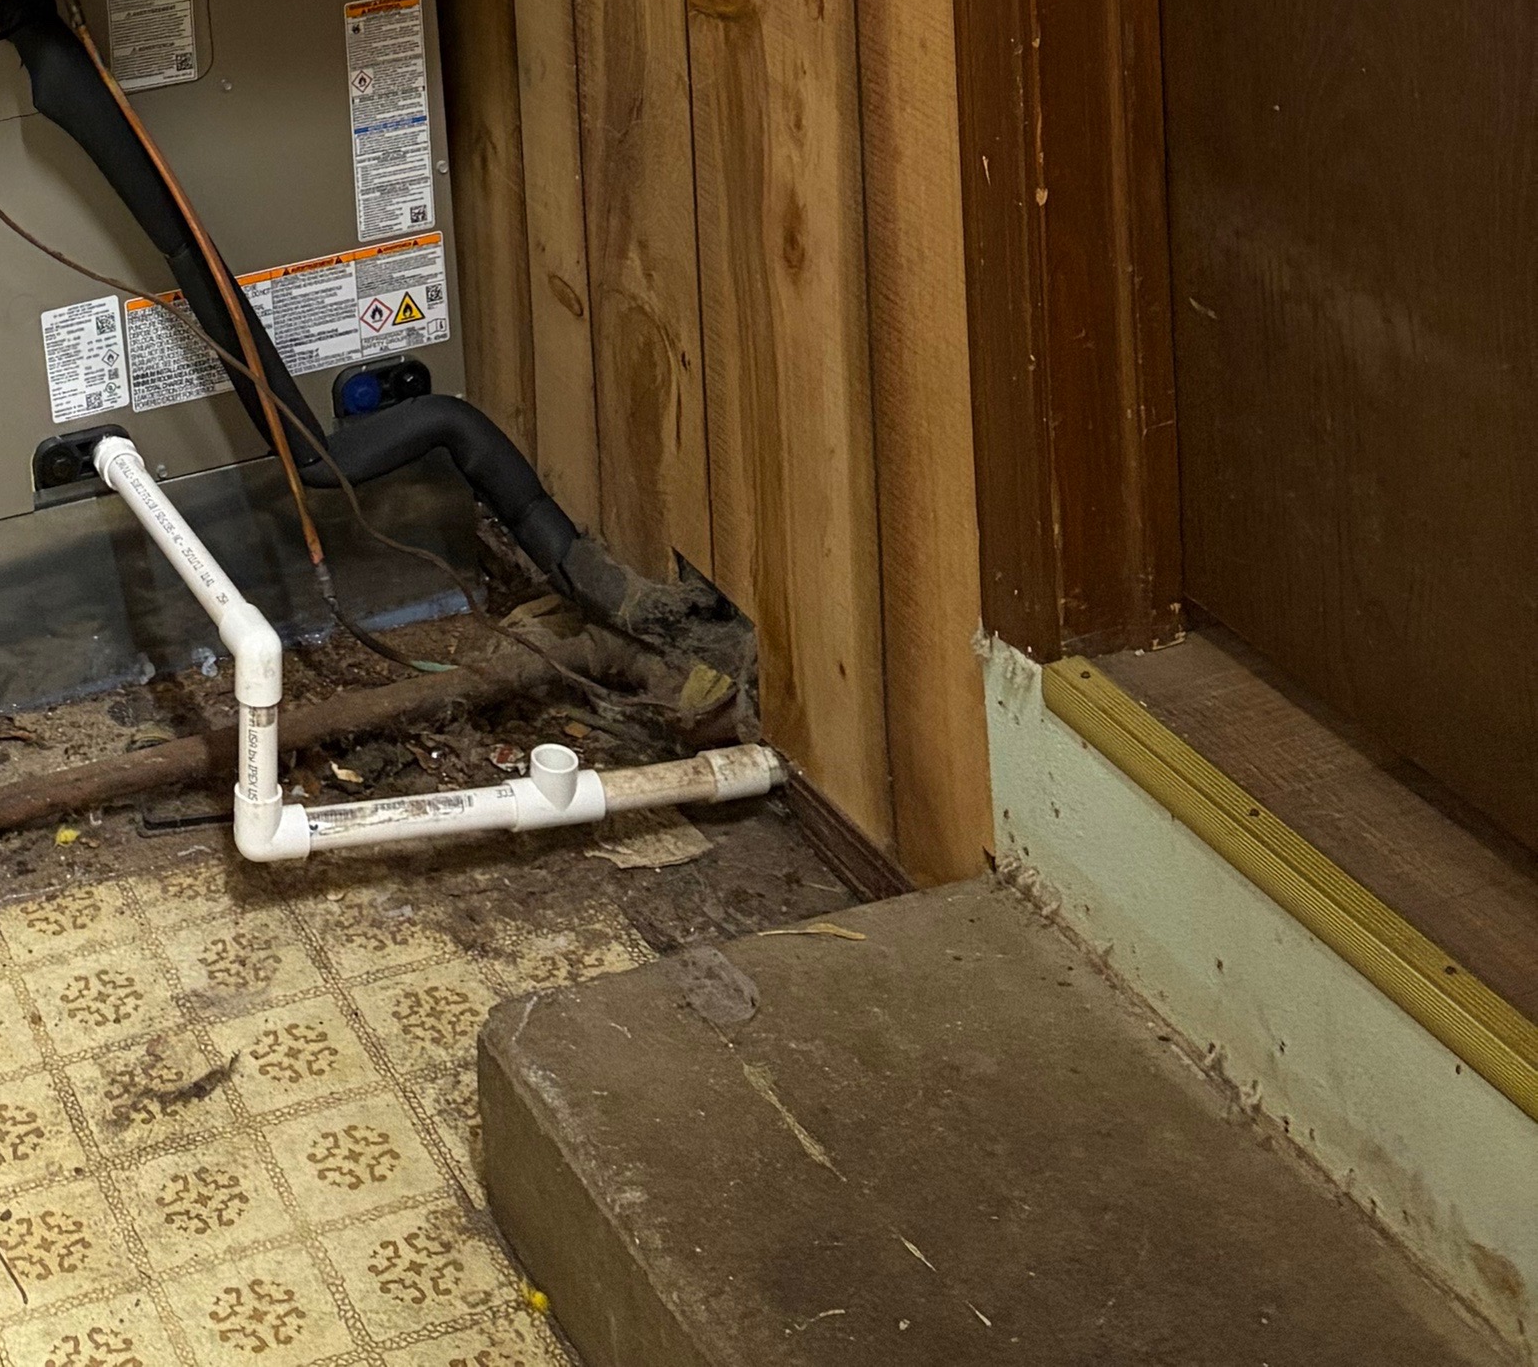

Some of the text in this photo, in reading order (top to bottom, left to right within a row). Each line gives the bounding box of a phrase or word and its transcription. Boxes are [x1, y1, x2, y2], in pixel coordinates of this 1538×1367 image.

[248, 729, 258, 748] USA
[248, 750, 257, 763] by
[248, 765, 259, 788] IPEX
